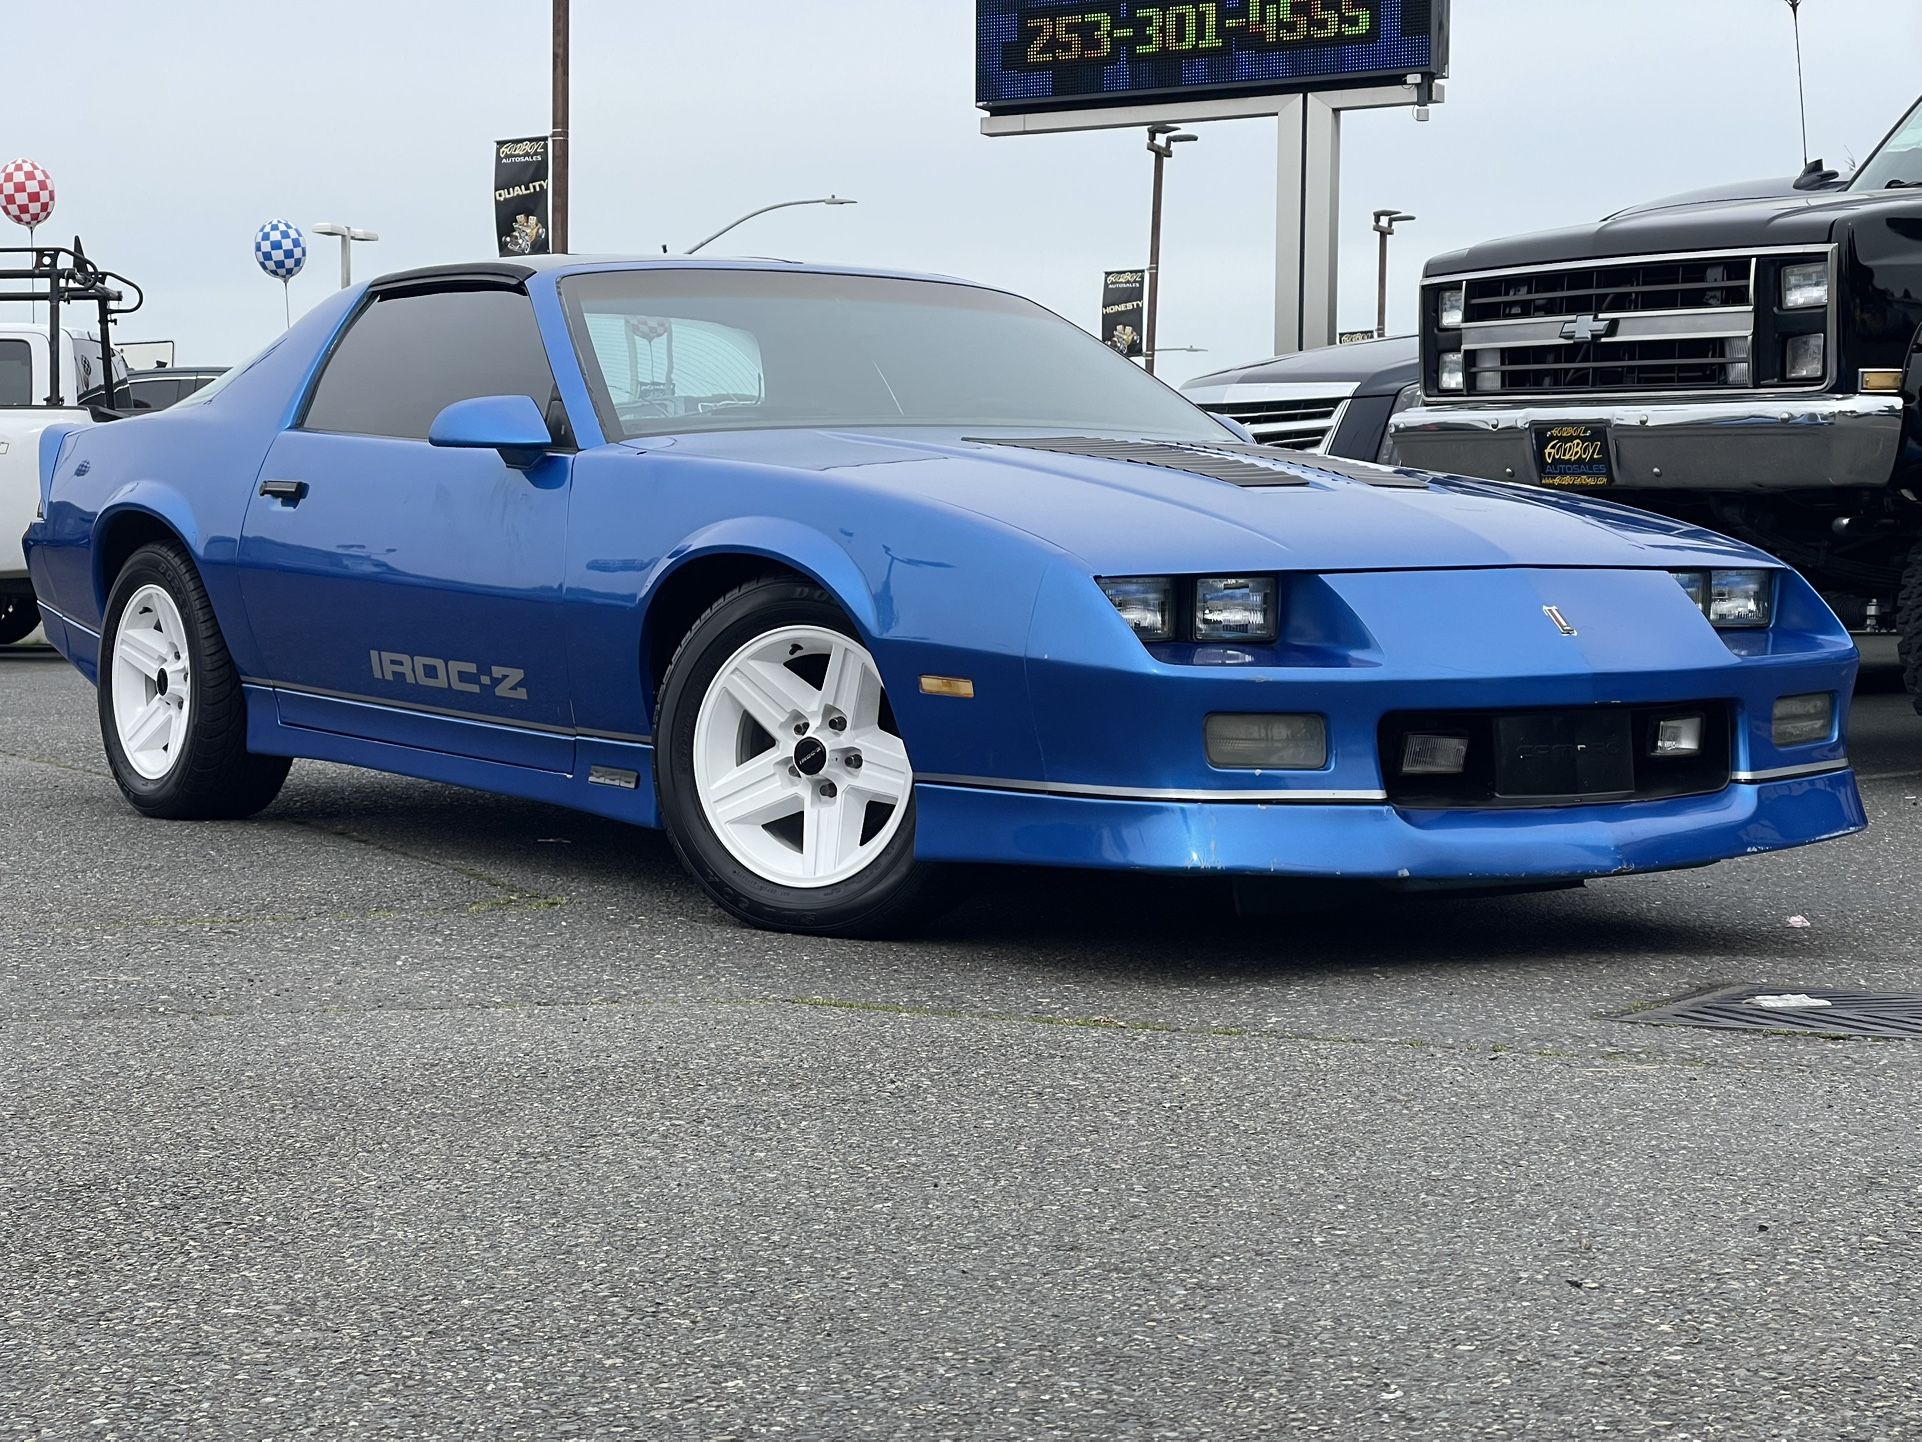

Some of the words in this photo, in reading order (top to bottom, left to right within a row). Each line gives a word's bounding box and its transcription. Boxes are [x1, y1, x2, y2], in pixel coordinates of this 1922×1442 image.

[1027, 0, 1370, 63] 253-301-4555
[502, 155, 541, 164] AUTOSALES
[495, 179, 549, 201] QUALITY
[1103, 300, 1143, 315] HONESTY
[1545, 464, 1606, 473] AUTOSALES
[369, 650, 528, 700] IROC-Z
